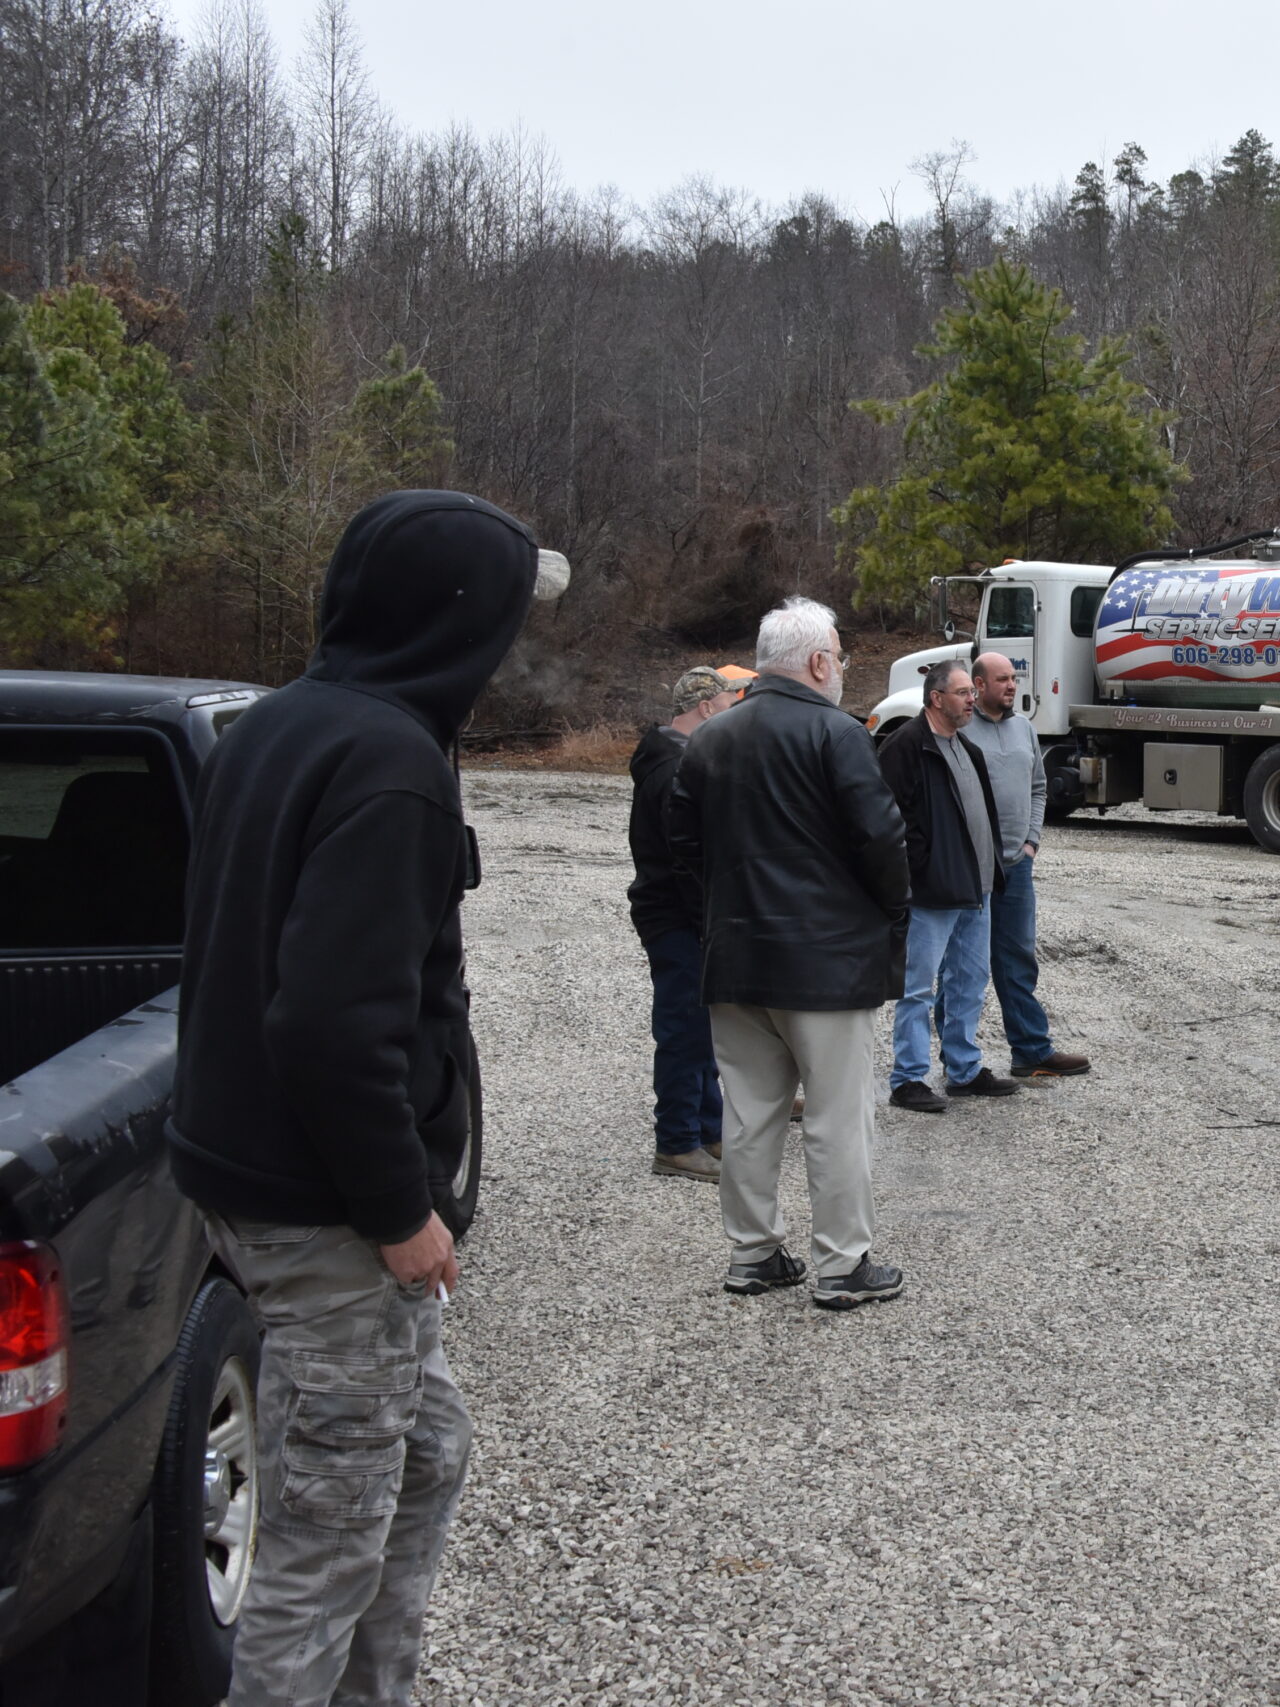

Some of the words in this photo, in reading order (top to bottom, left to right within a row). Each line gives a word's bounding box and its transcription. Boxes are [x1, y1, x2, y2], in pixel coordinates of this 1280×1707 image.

[1143, 617, 1239, 641] SEPTIC
[1114, 708, 1144, 727] Your
[1147, 712, 1162, 724] #2
[1166, 714, 1217, 728] Business
[1220, 718, 1230, 728] is
[1233, 716, 1256, 729] Our
[1259, 717, 1273, 729] #1
